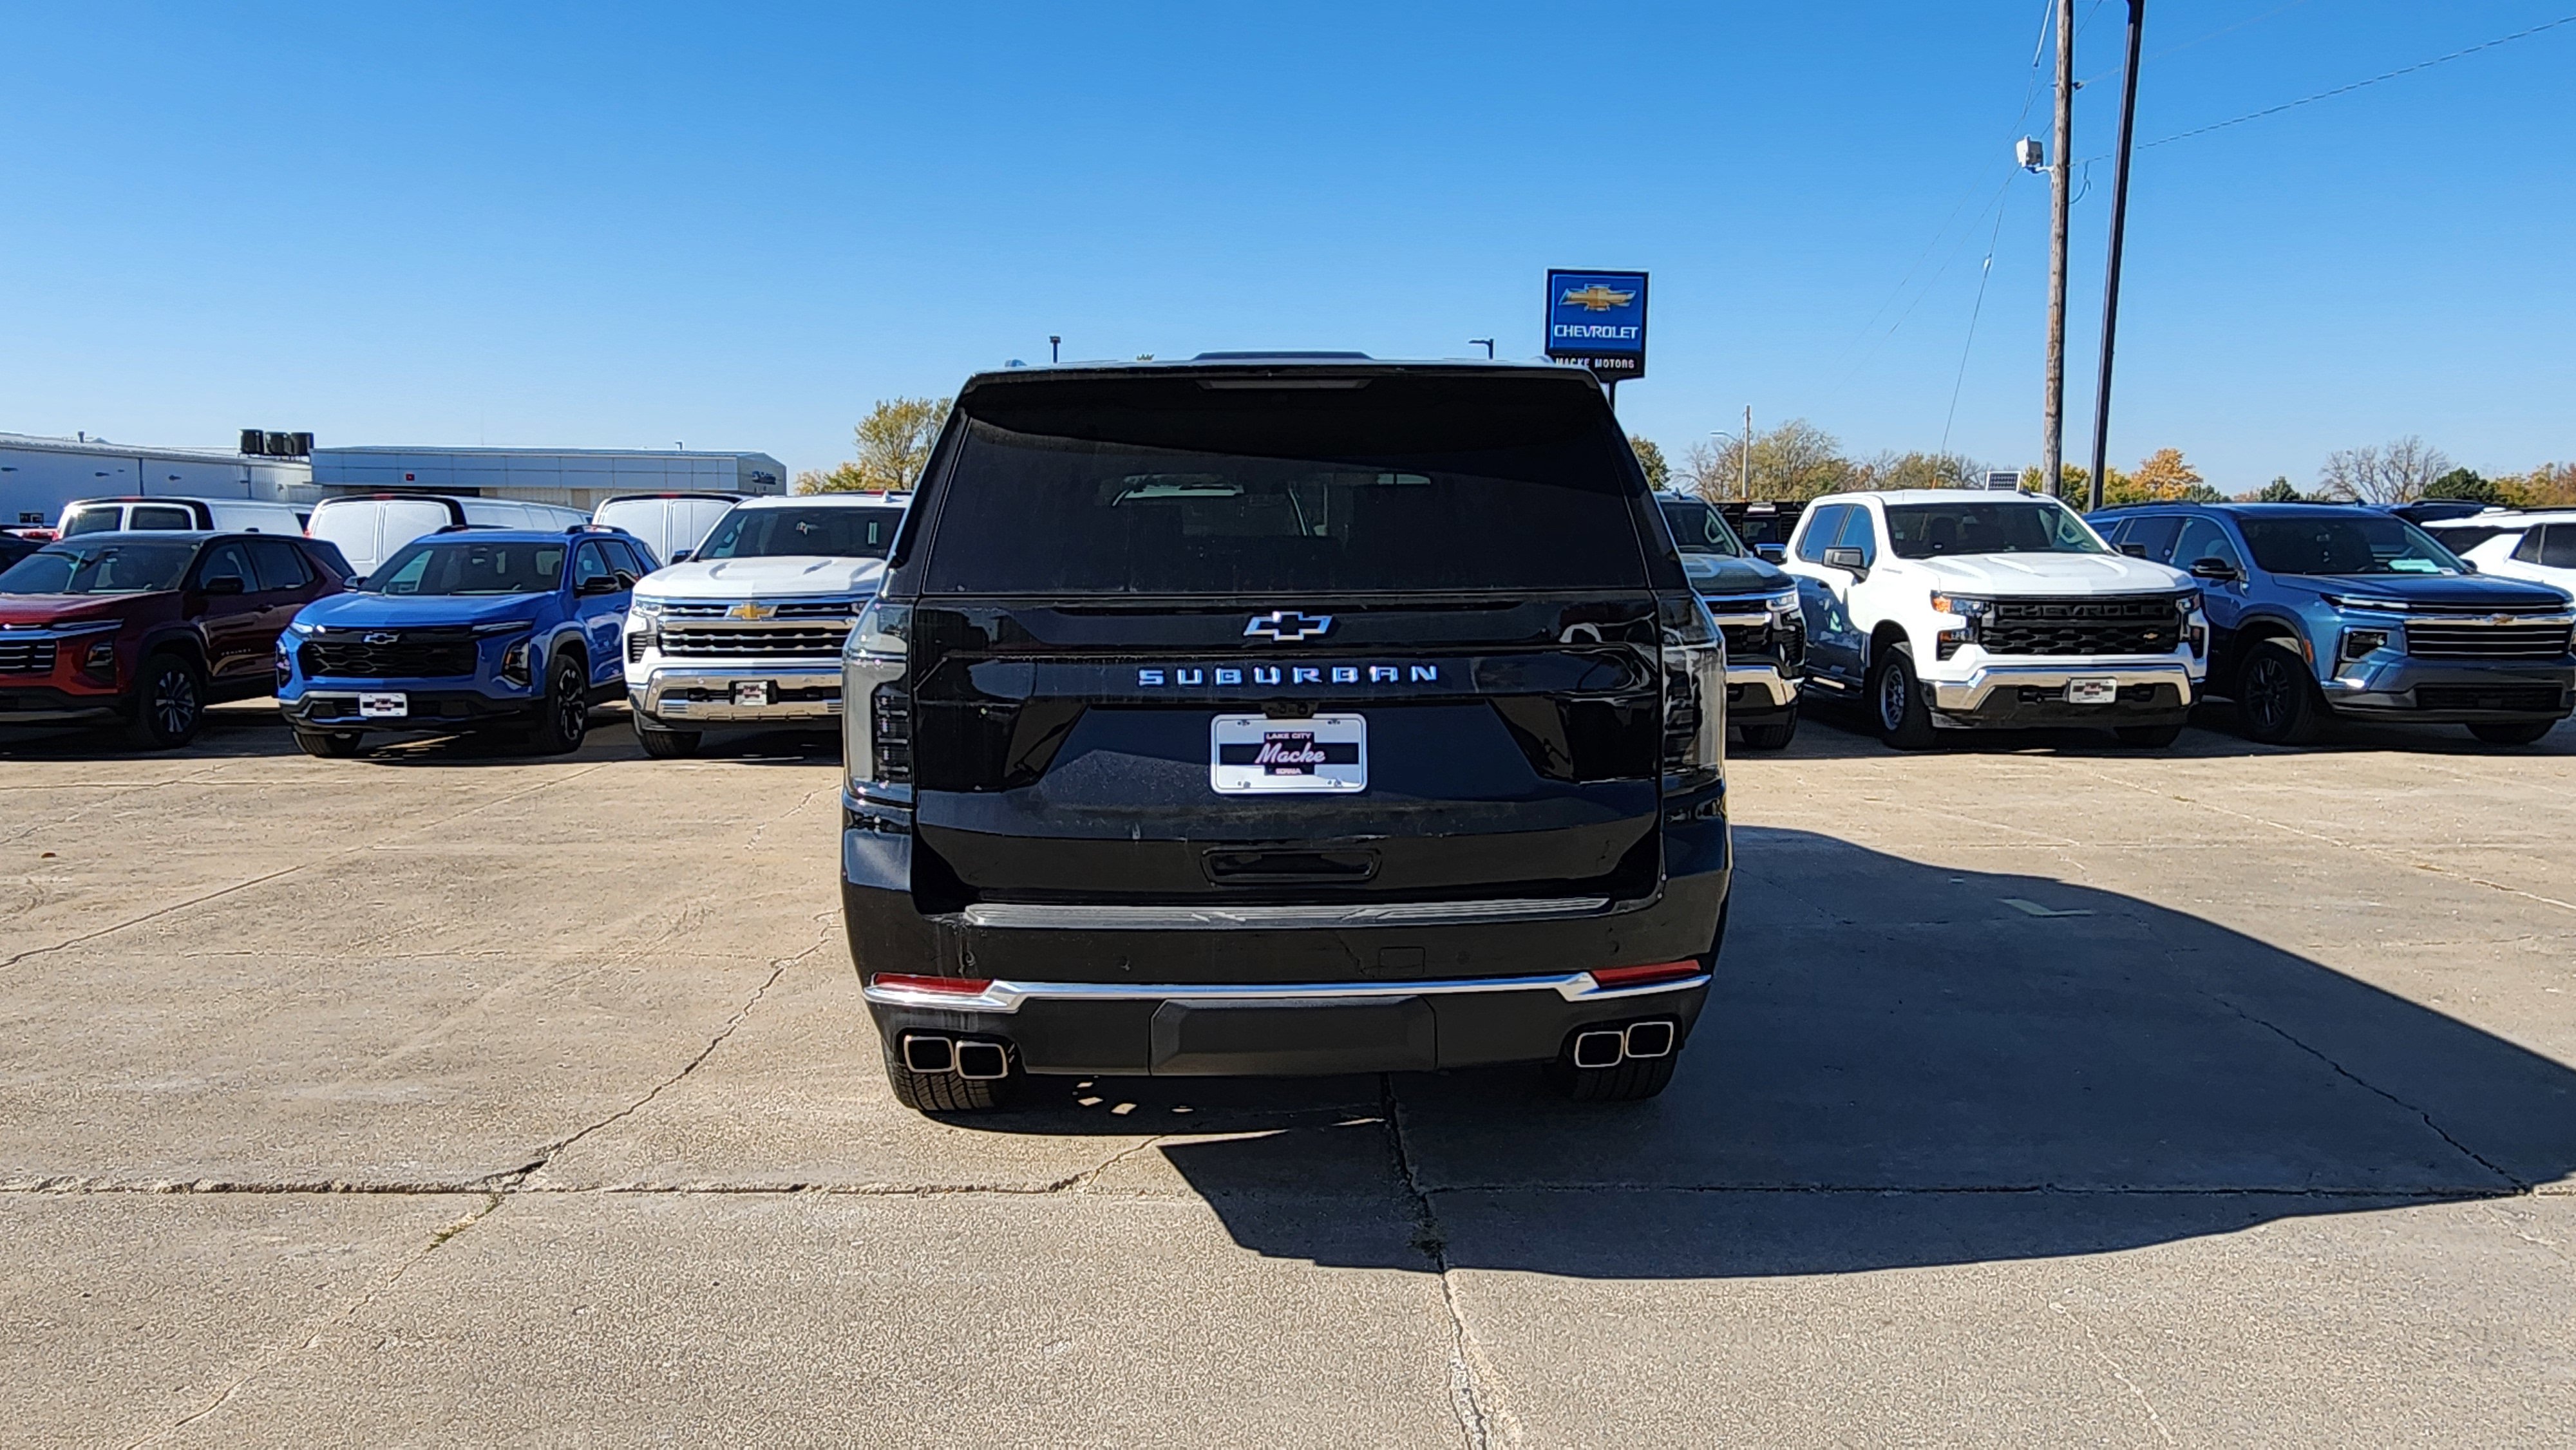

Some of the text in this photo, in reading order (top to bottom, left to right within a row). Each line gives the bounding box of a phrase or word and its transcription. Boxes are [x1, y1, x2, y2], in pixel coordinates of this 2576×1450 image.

[1554, 324, 1639, 339] CHEVROLET
[1139, 666, 1437, 686] SUBURBAN
[1255, 742, 1326, 764] Macke
